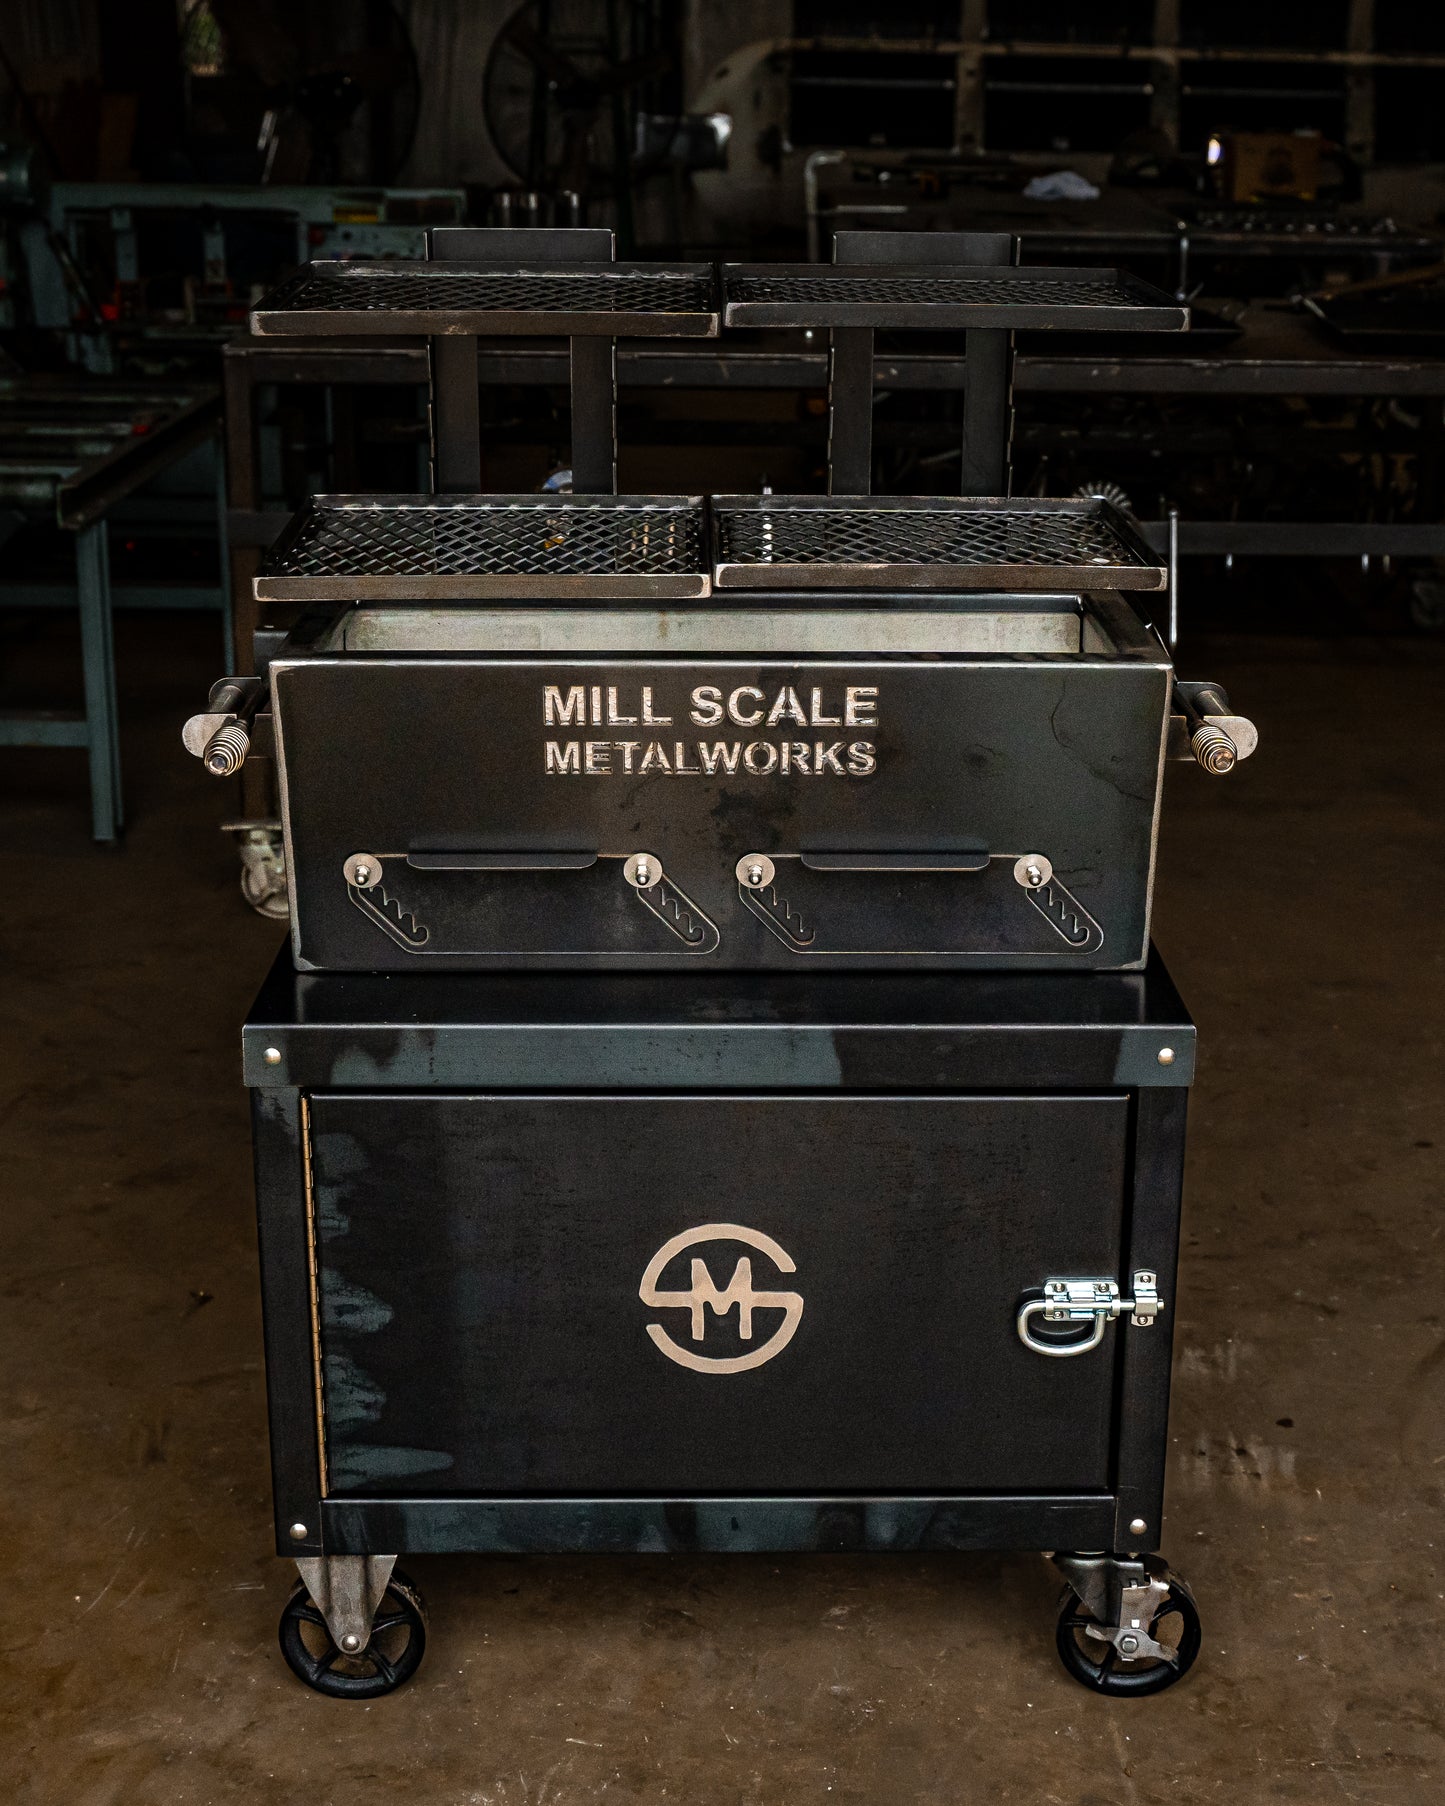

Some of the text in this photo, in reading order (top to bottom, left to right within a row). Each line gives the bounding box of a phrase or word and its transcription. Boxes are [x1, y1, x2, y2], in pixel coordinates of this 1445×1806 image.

[543, 685, 880, 727] MILL SCALE
[544, 740, 878, 777] METALWORKS
